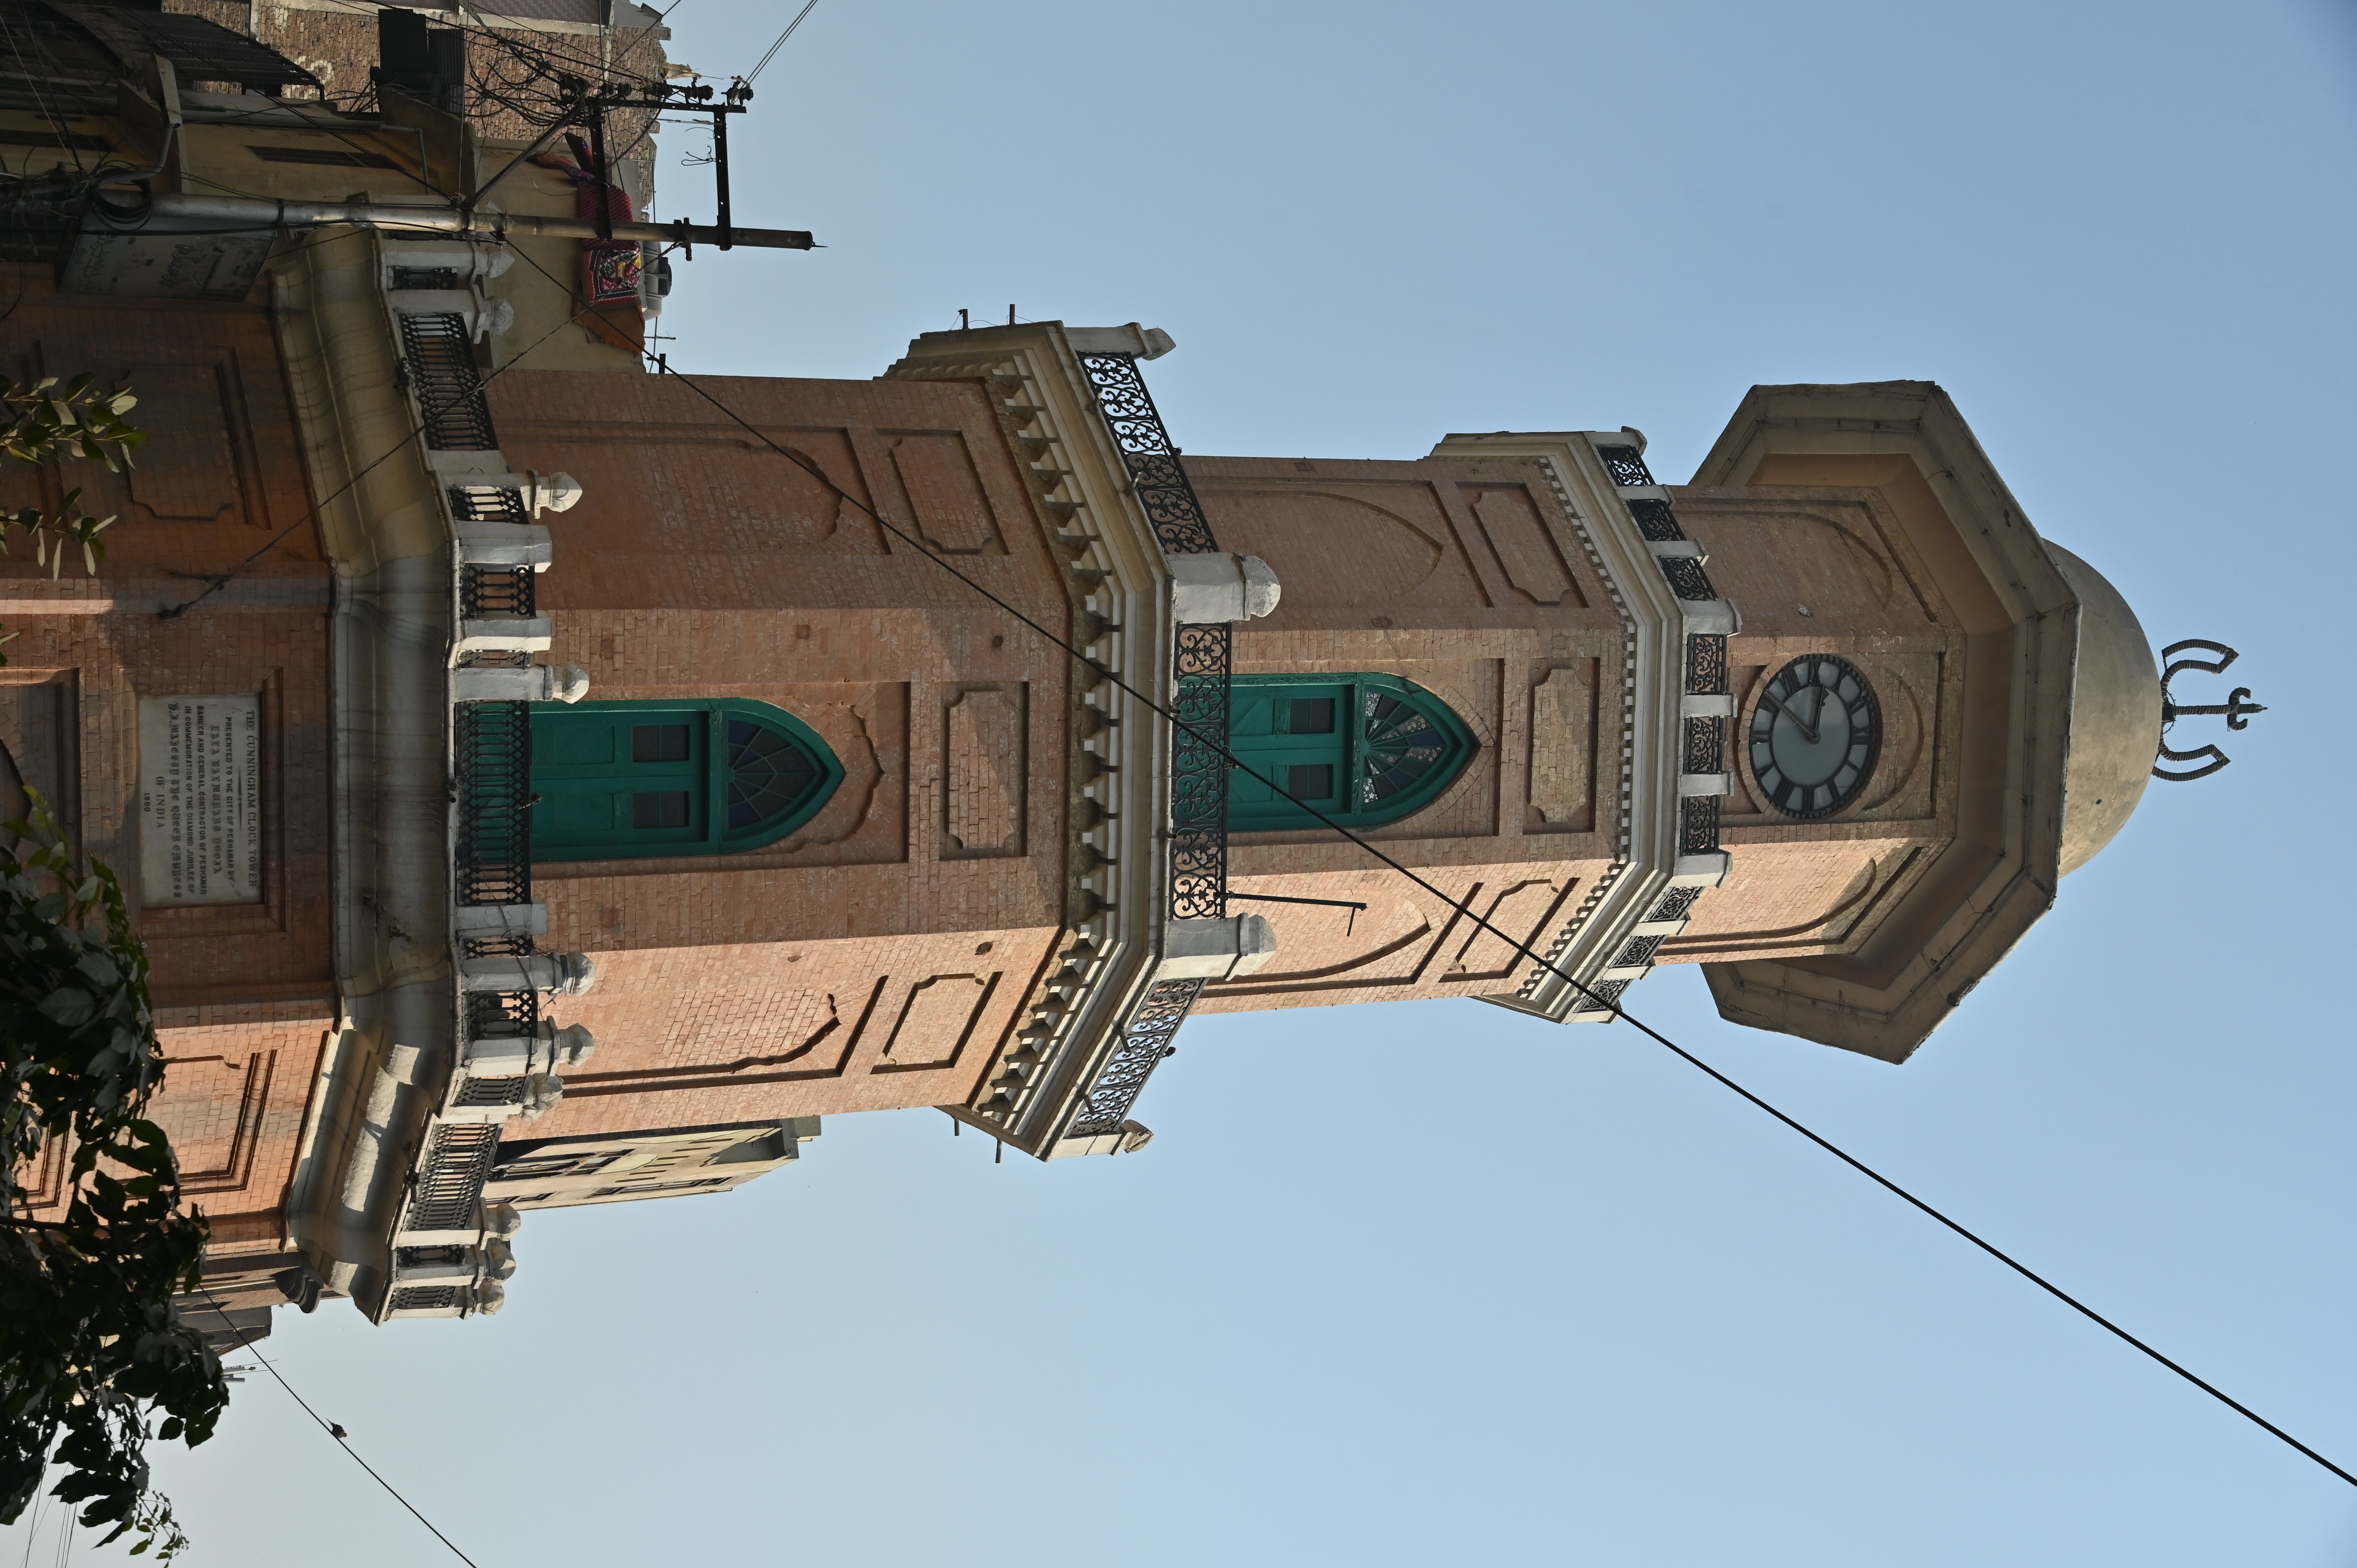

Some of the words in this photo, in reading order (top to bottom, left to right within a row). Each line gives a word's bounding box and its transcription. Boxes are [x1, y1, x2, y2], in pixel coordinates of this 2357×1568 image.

[210, 725, 219, 755] LALA
[226, 766, 233, 775] TO
[247, 736, 255, 808] CUNNINGHAM
[156, 777, 165, 788] OF
[186, 784, 193, 792] OF
[170, 780, 180, 800] THE
[156, 795, 165, 828] INDIA
[171, 805, 180, 842] QUEEN
[227, 816, 233, 825] OF
[199, 843, 206, 852] OF
[171, 845, 182, 897] EMPRESS
[228, 871, 234, 881] BY
[188, 884, 194, 893] OF
